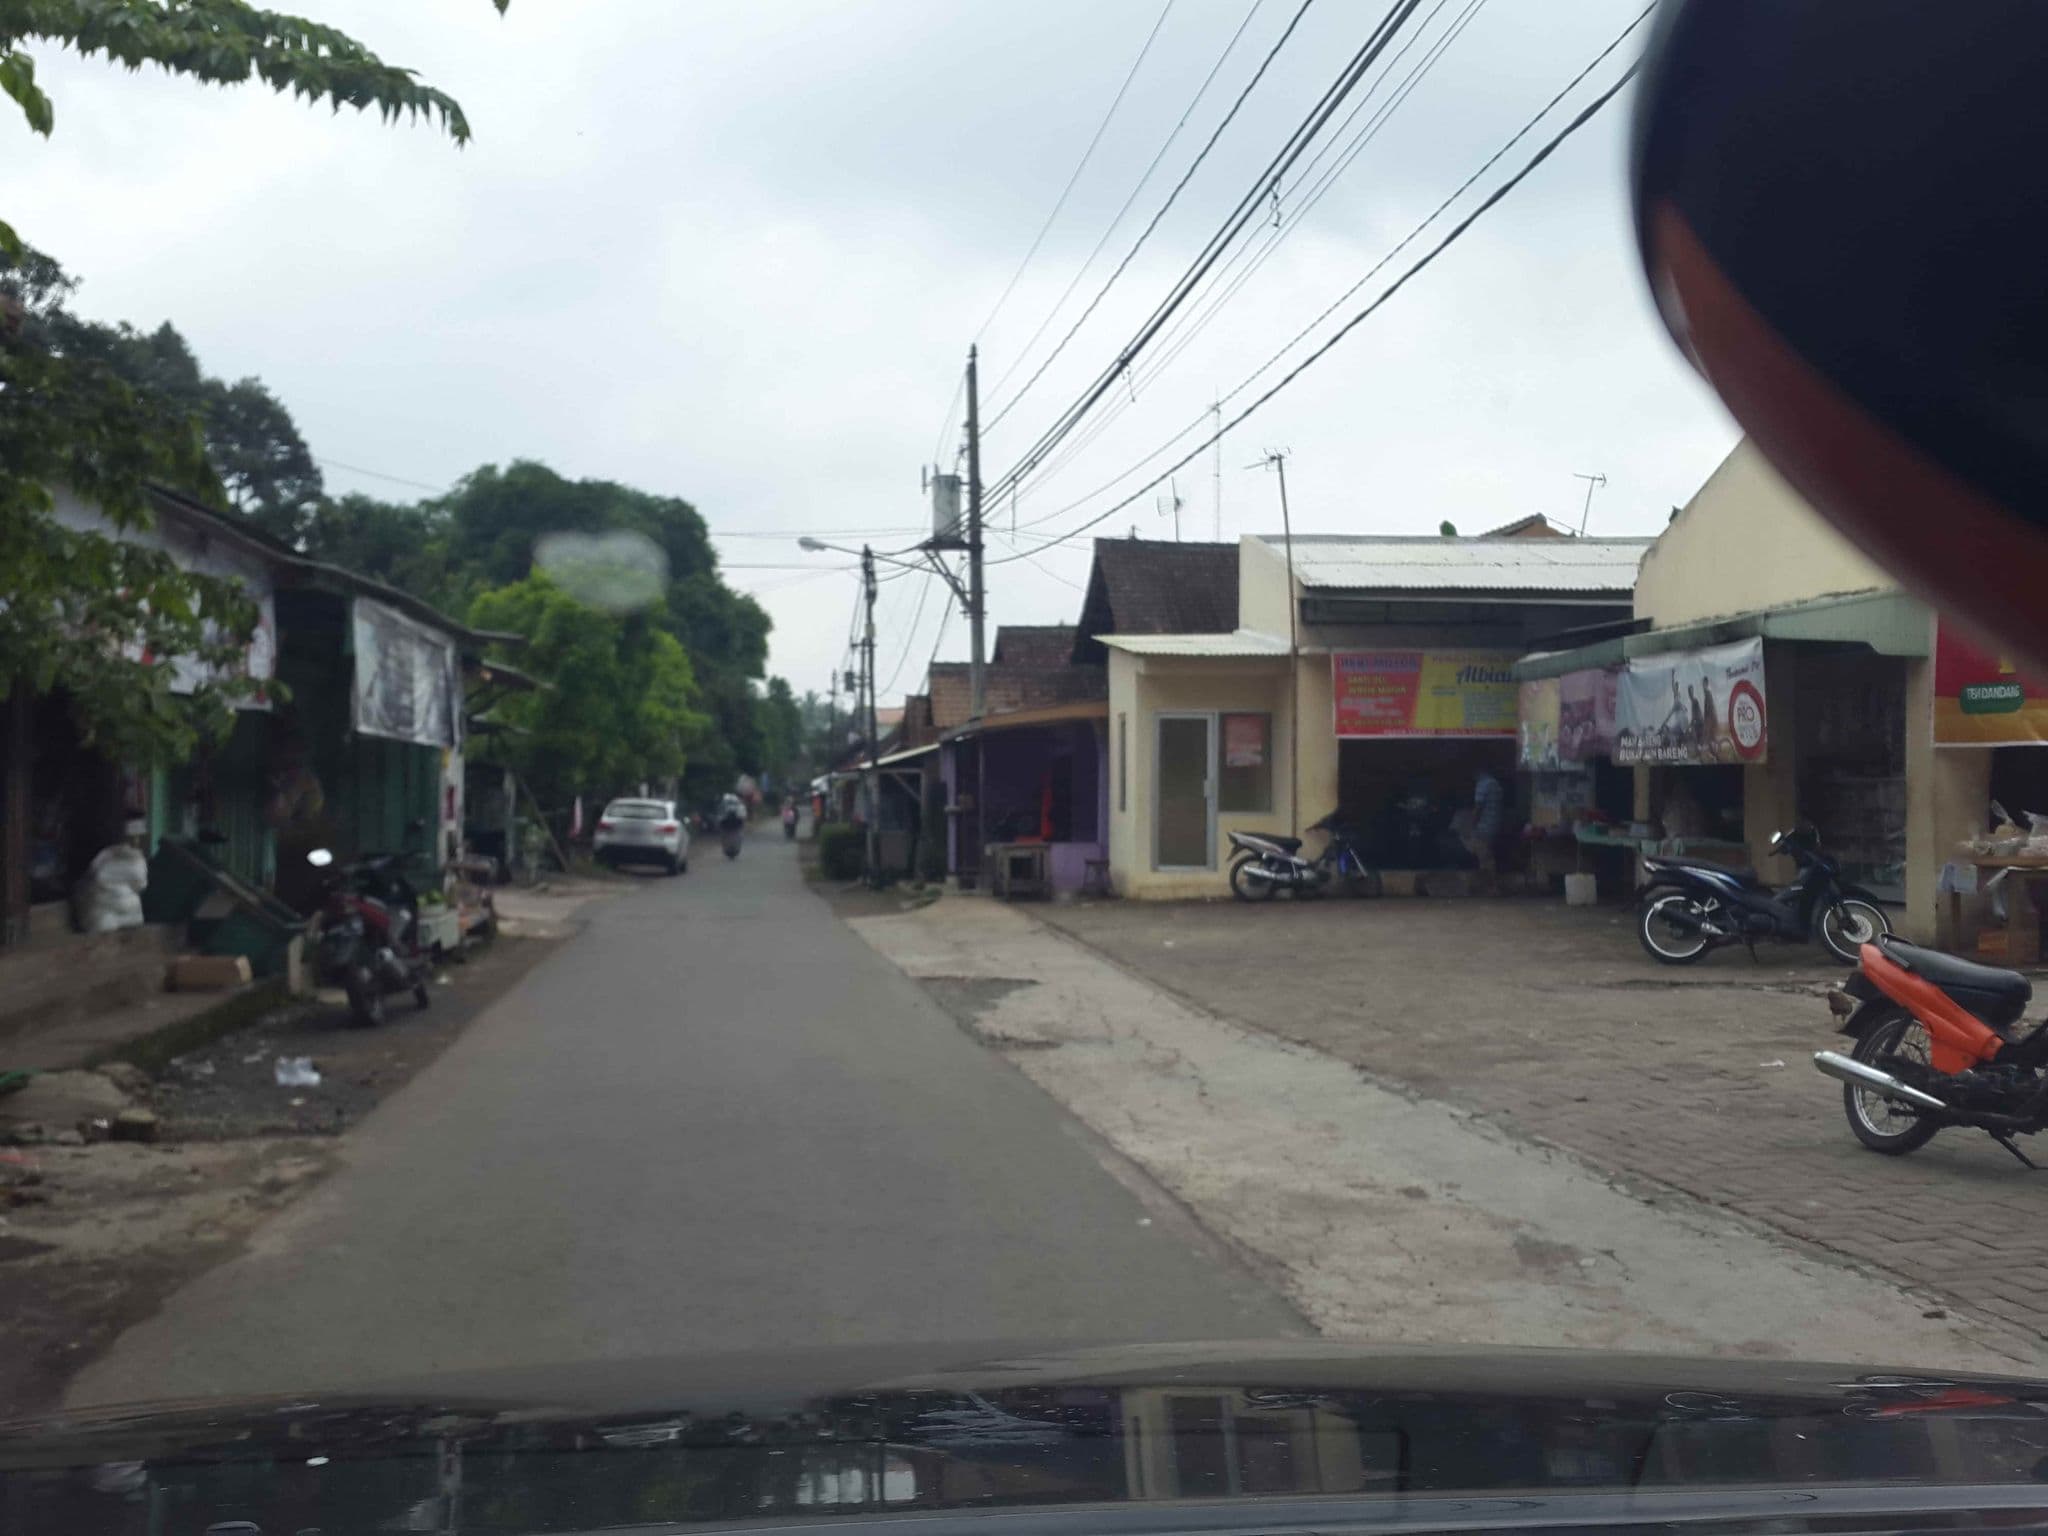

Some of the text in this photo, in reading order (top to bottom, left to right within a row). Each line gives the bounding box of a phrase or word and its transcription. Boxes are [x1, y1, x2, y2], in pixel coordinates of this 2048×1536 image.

[1982, 685, 2020, 699] DANDANG
[1737, 705, 1755, 723] PRO
[1658, 744, 1688, 760] BARENG
